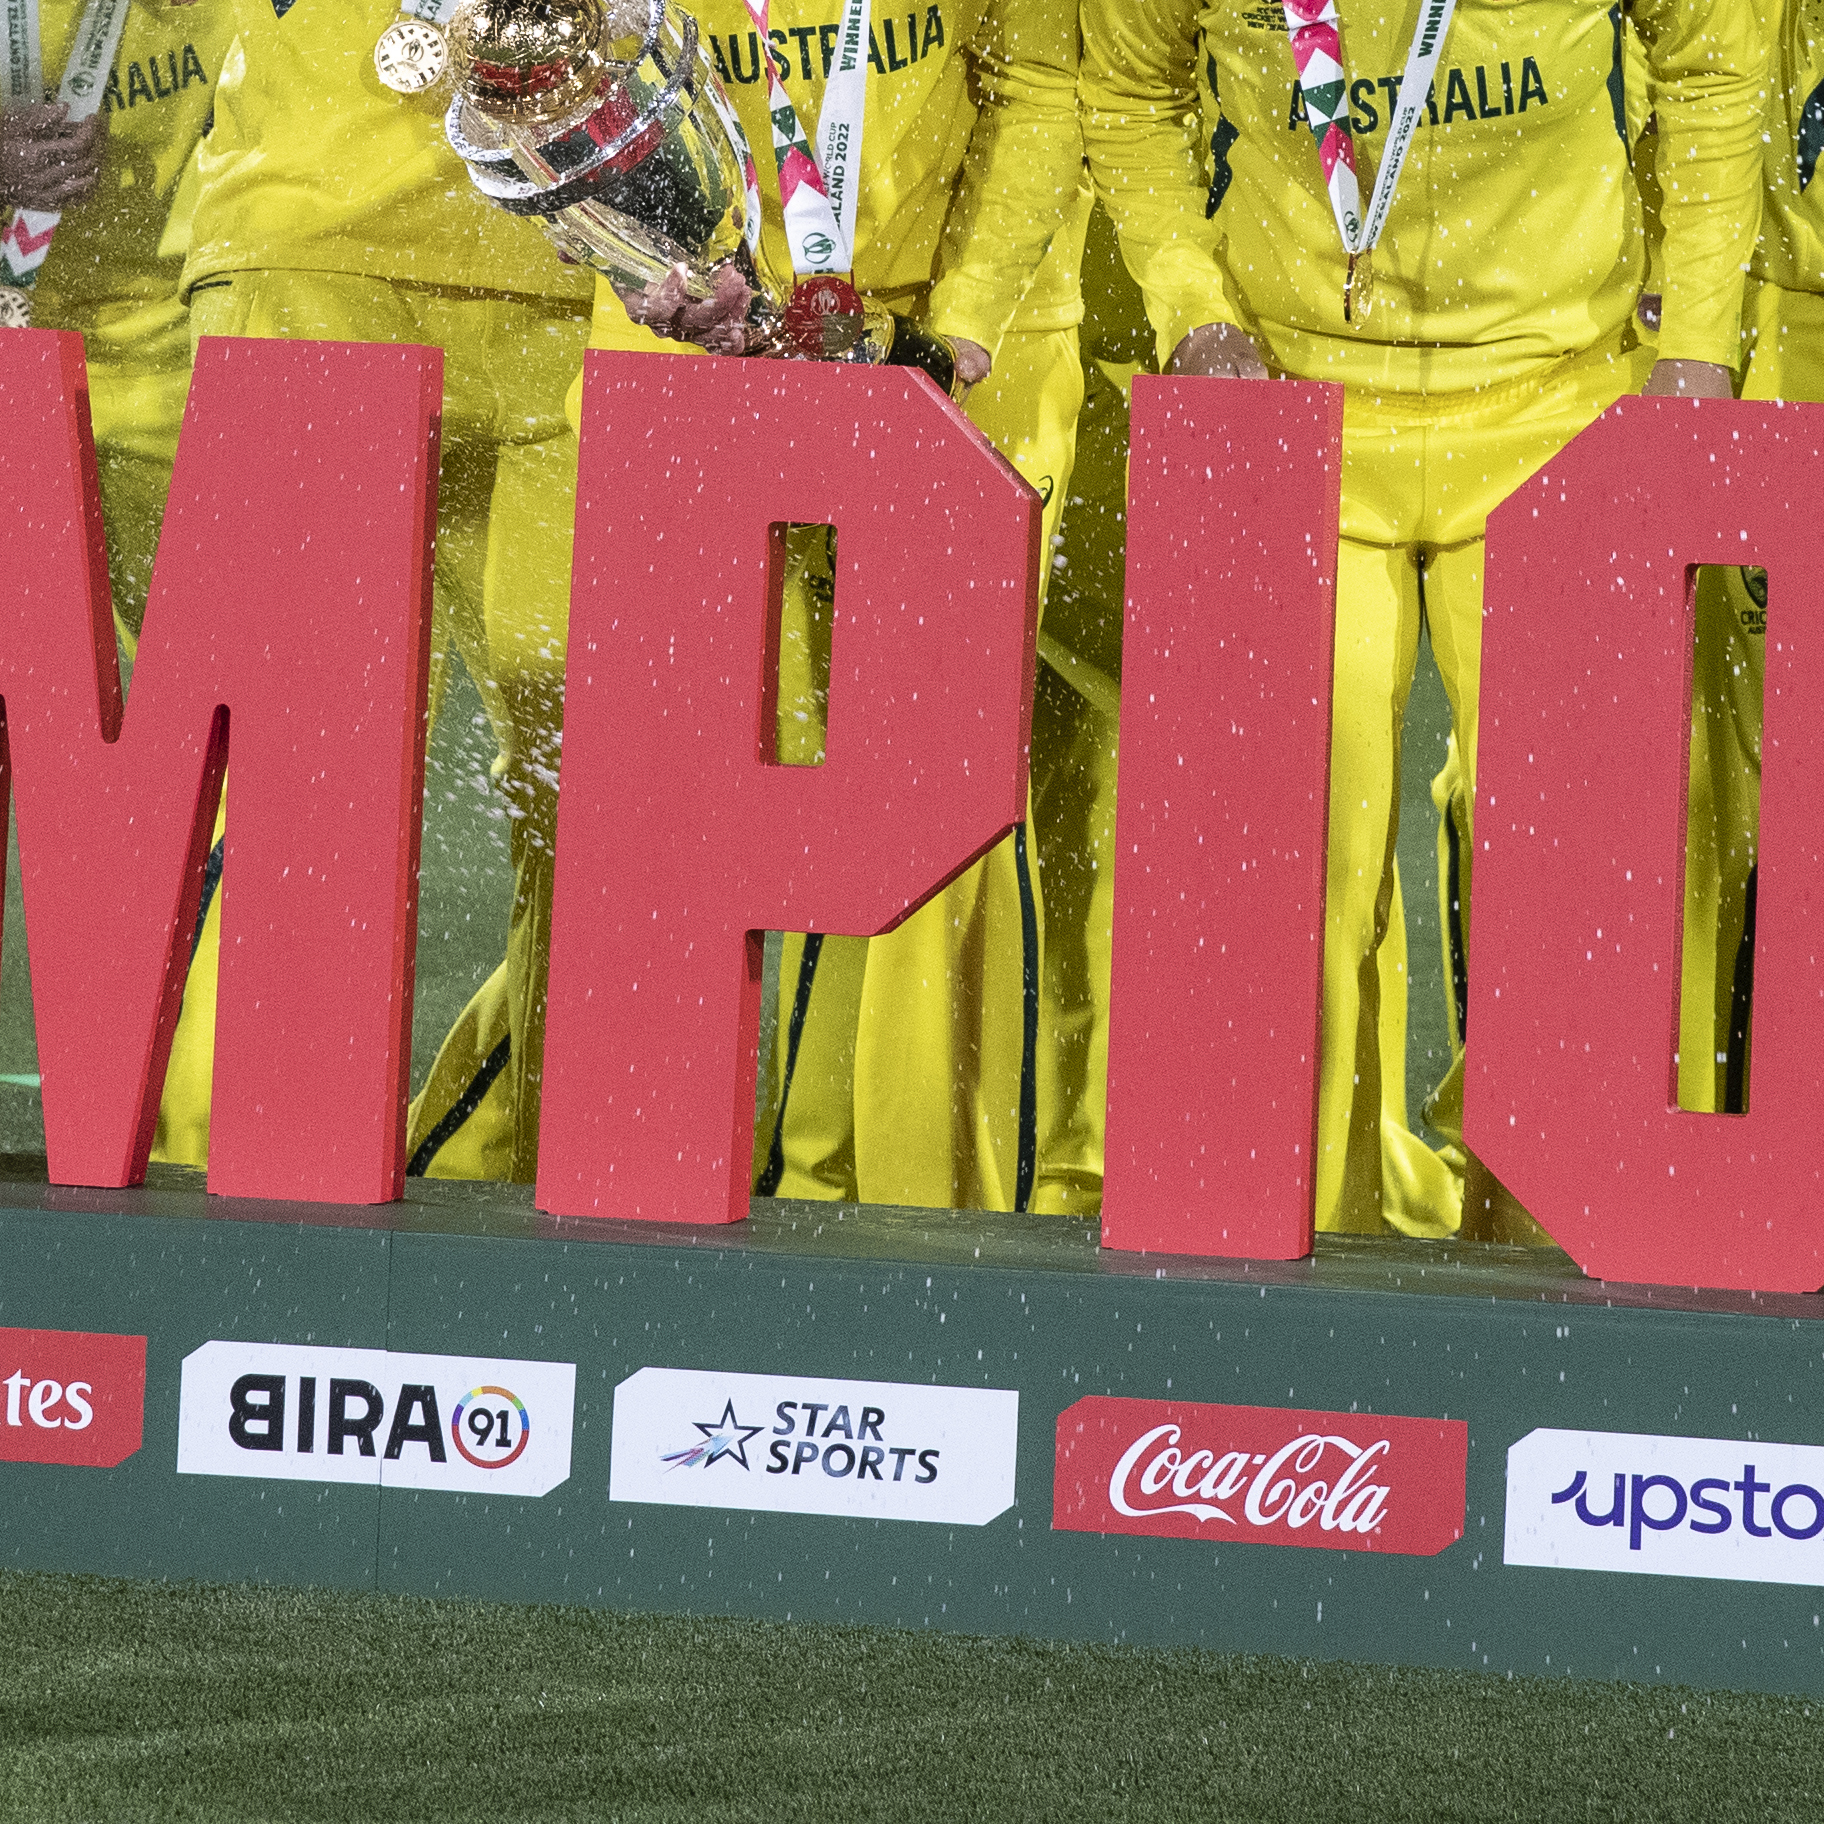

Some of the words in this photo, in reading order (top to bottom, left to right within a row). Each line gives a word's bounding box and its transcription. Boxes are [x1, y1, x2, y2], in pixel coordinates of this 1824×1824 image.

[1287, 55, 1549, 135] ASTRALIA
[828, 121, 838, 142] CUP
[834, 122, 850, 162] 2022
[1377, 147, 1404, 221] ZEALAND
[1399, 105, 1416, 142] 2022
[830, 164, 845, 230] ALAND
[227, 1372, 448, 1465] BIRA
[467, 1409, 513, 1449] 91
[772, 1400, 887, 1443] STAR
[765, 1440, 942, 1485] SPORTS
[1108, 1423, 1391, 1536] Coca-Cola
